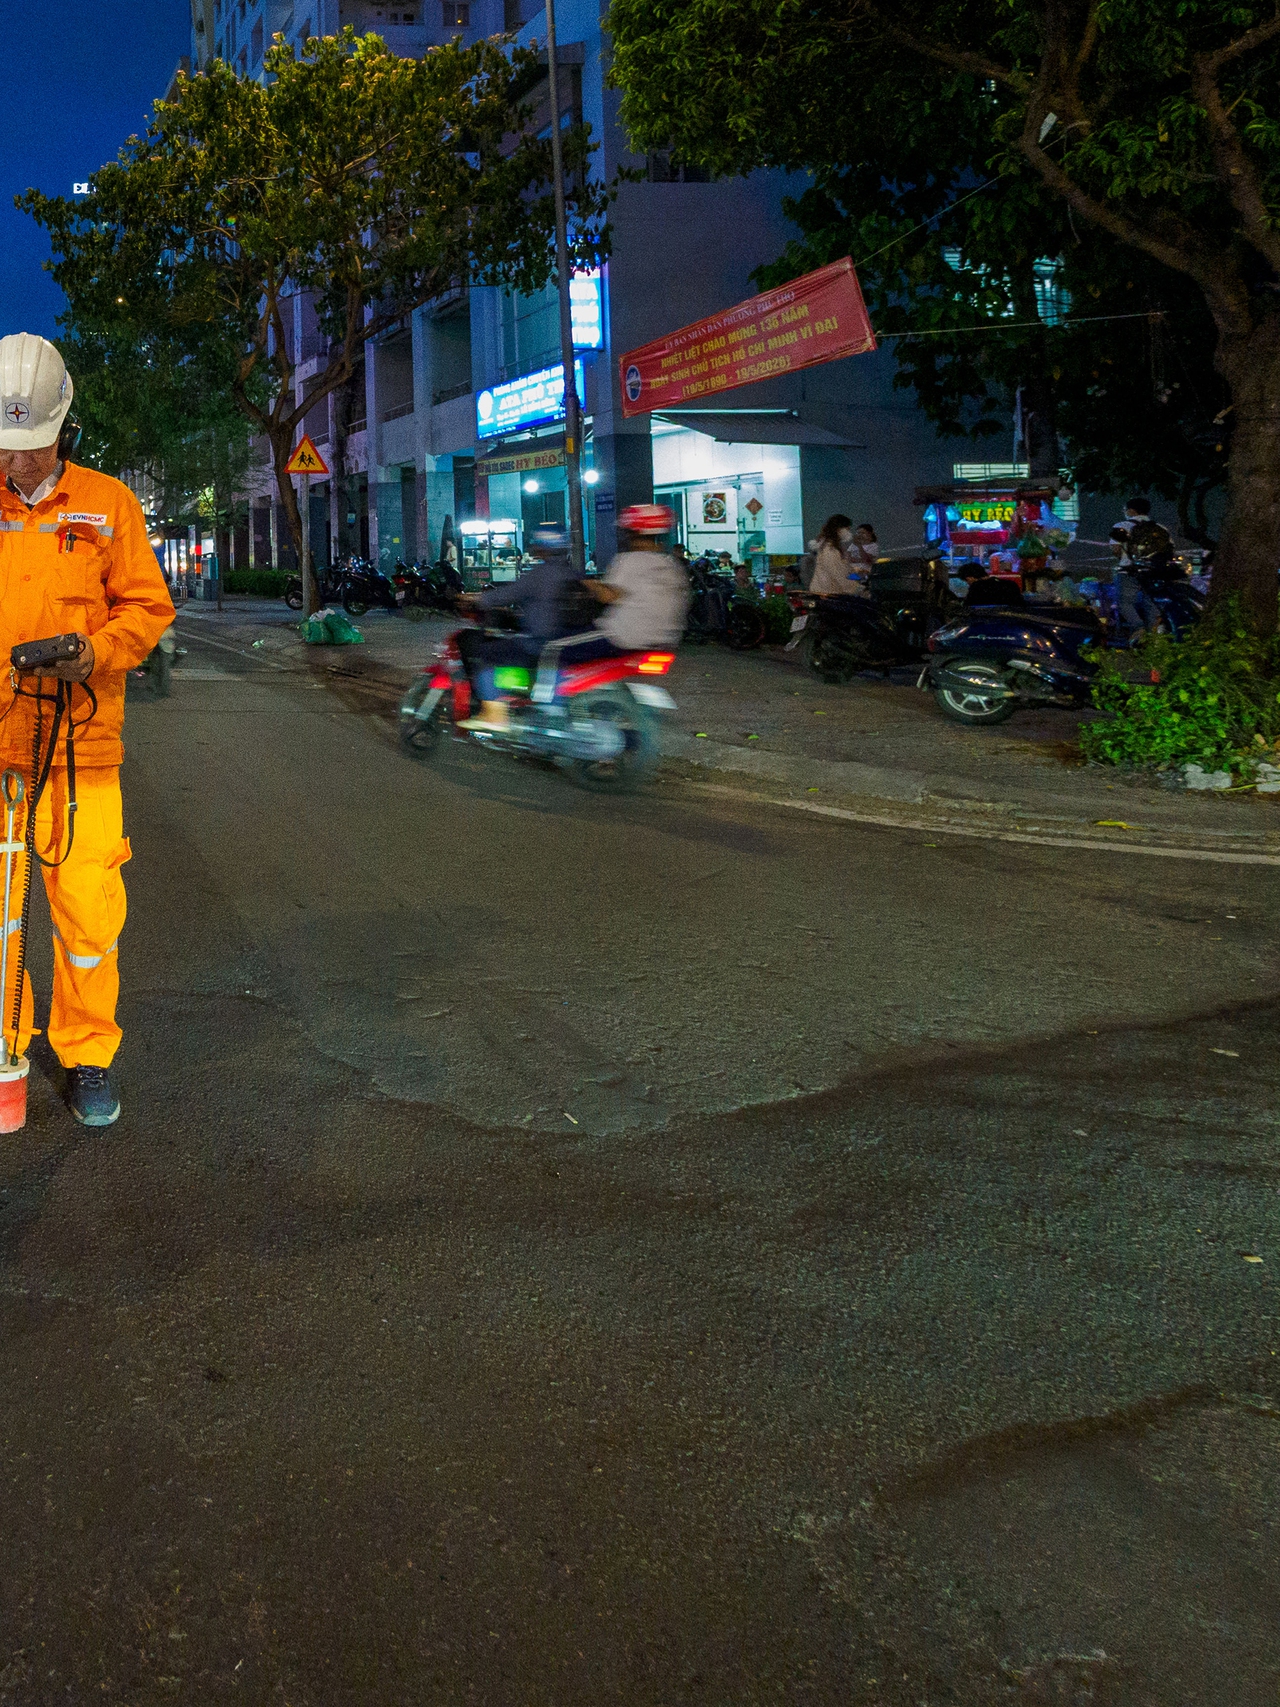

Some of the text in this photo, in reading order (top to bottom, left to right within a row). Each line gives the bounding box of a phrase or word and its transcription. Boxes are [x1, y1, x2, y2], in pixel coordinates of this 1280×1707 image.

[684, 348, 700, 361] LIỆT
[703, 335, 726, 353] CHÀO
[728, 323, 757, 344] MỪNG
[781, 304, 809, 325] NĂM
[671, 367, 691, 382] SINH
[692, 360, 708, 375] CHỦ
[711, 354, 730, 371] TỊCH
[732, 345, 745, 362] HỒ
[748, 340, 765, 356] CHÍ
[768, 329, 798, 350] MINH
[516, 458, 530, 469] HY
[534, 452, 557, 466] BÉO
[72, 514, 104, 523] EVNHCMC
